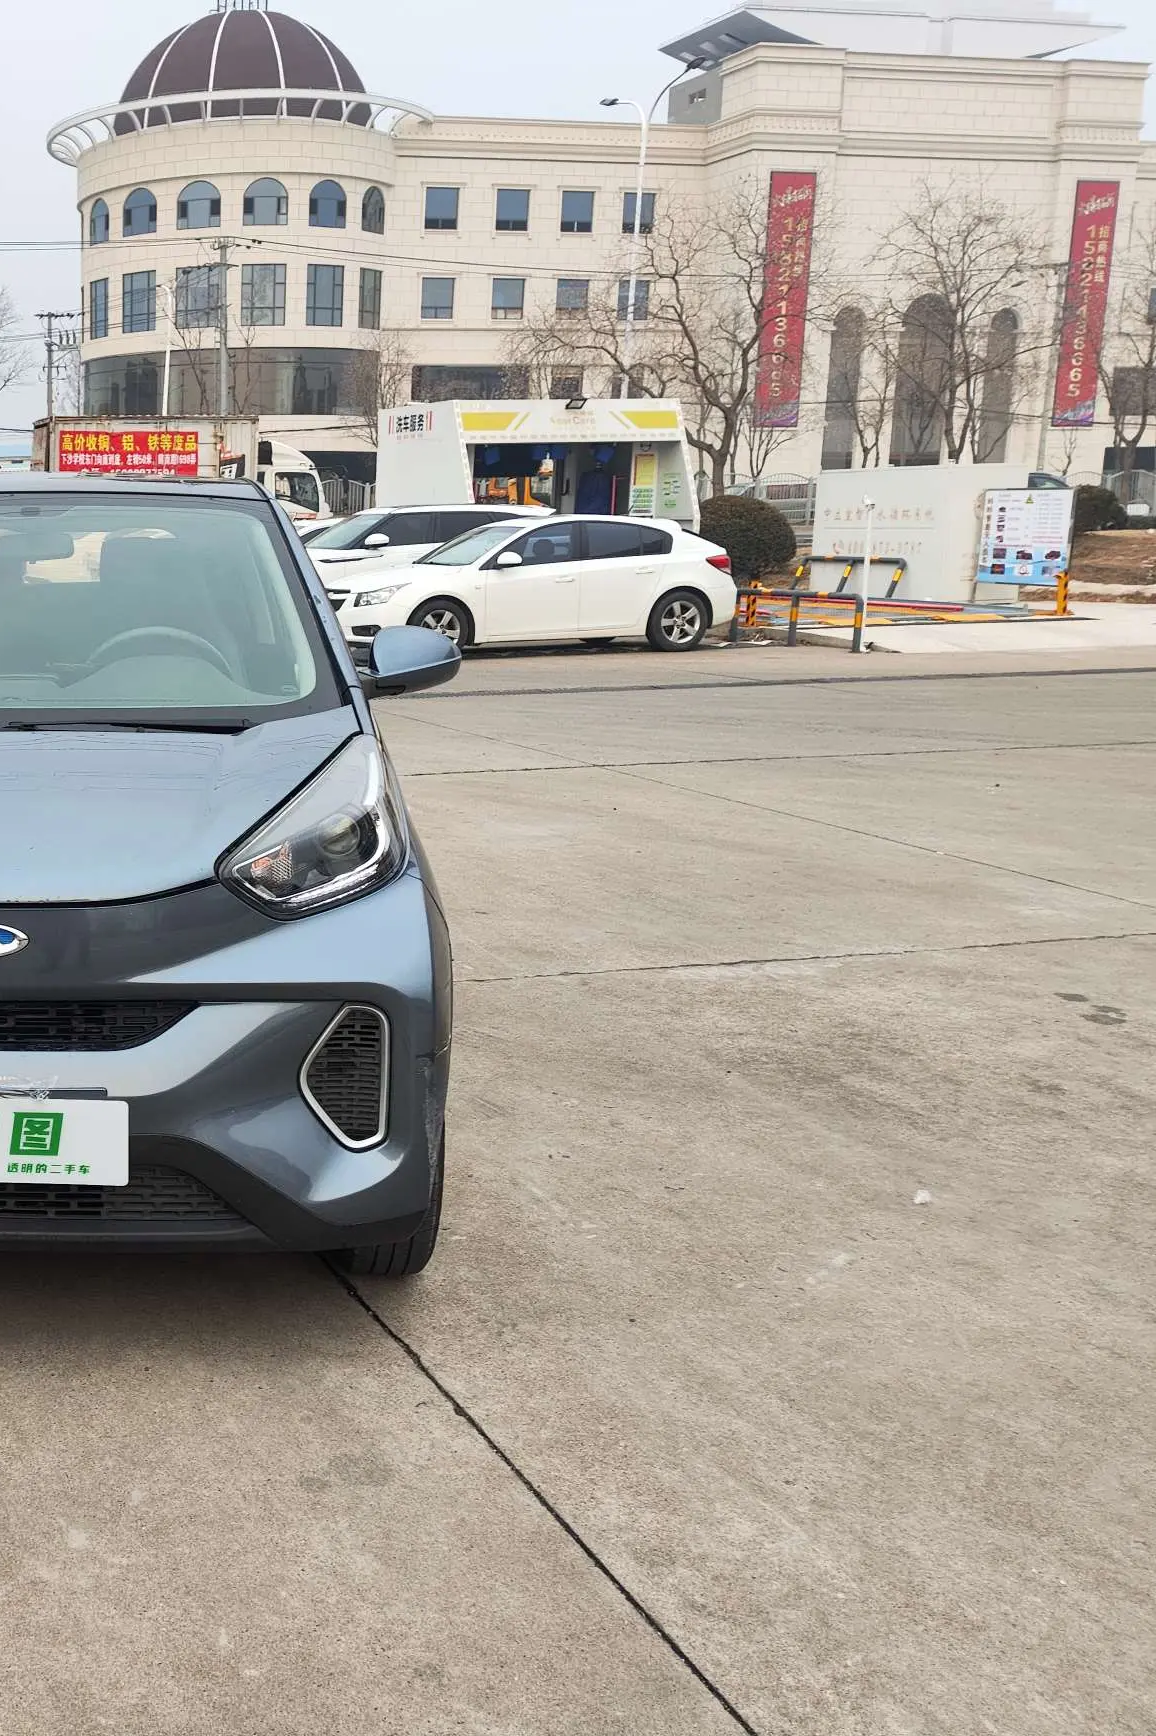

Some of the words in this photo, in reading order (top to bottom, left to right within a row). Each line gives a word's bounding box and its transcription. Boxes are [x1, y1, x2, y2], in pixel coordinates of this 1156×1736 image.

[1093, 225, 1111, 283] 招商热线
[396, 414, 424, 433] 洗车服务
[7, 1162, 91, 1175] 透明的二手车
